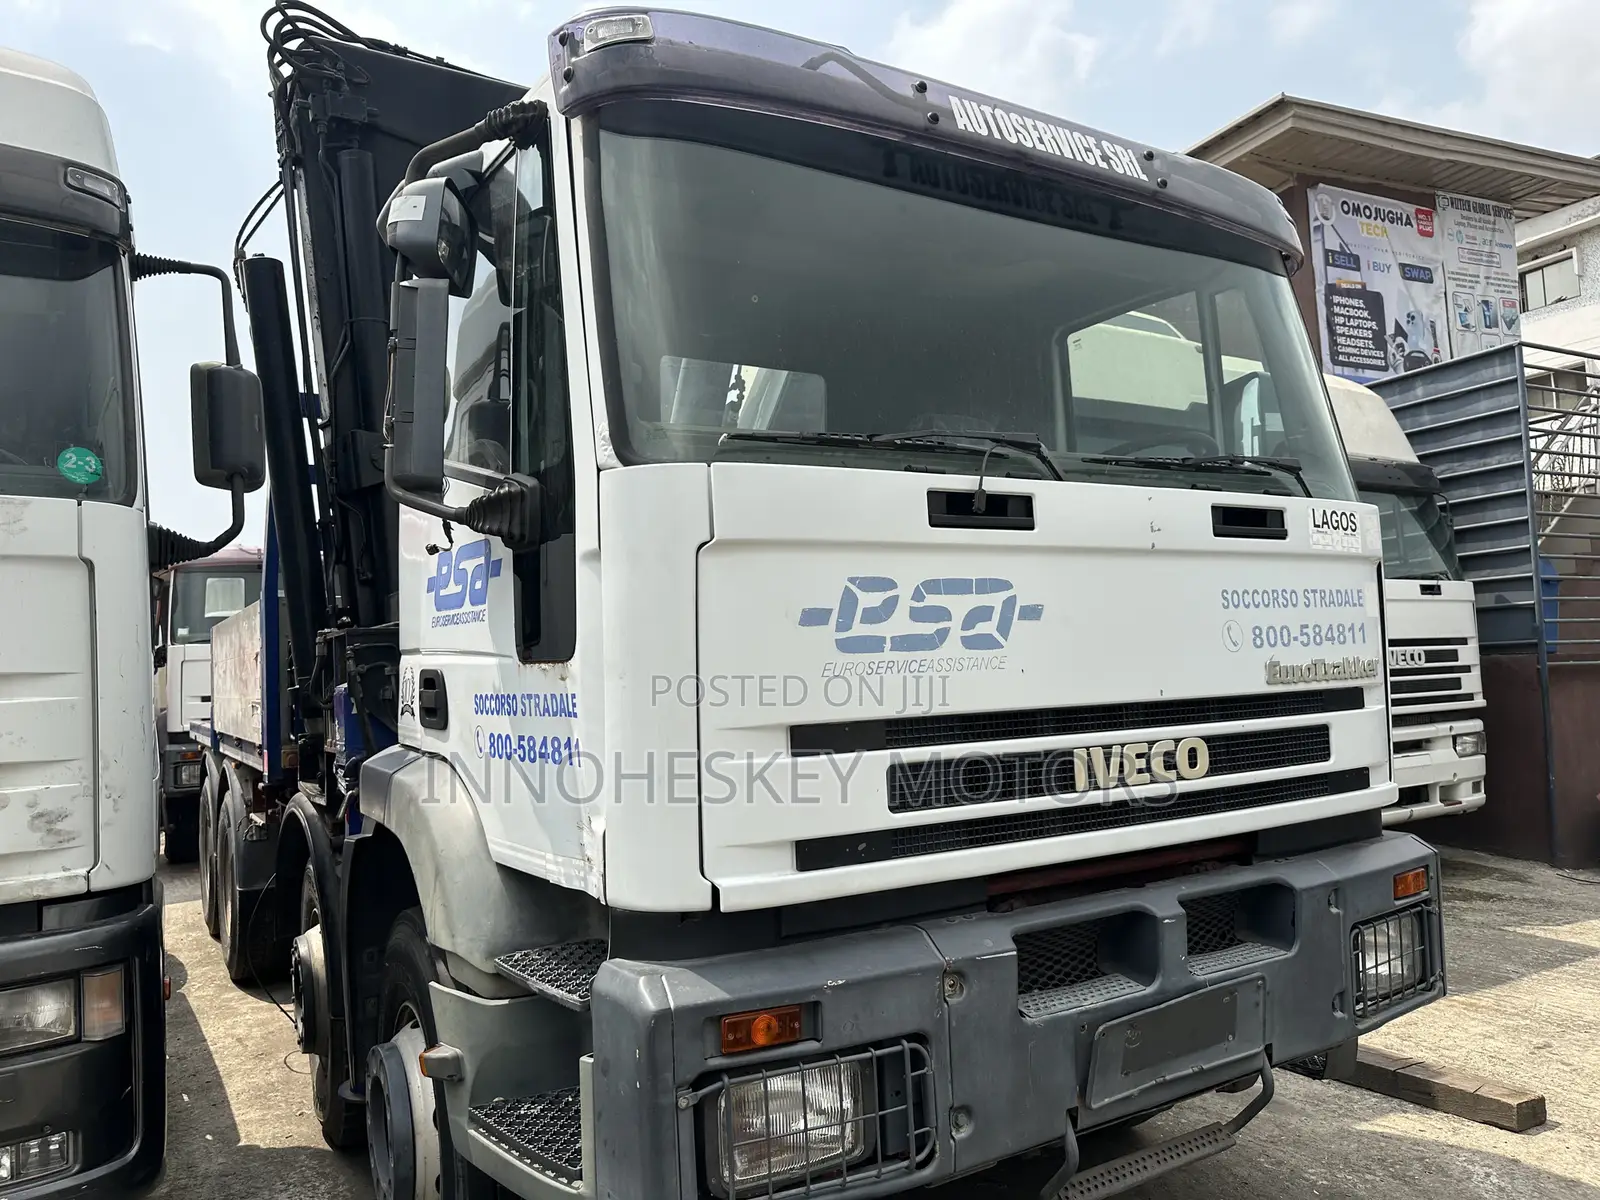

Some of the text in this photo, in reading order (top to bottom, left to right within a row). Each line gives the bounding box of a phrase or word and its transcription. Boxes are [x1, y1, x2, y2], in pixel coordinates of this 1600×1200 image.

[949, 95, 1149, 181] AUTOSERVICE SRL
[1340, 200, 1414, 228] OMOJUGHA
[1472, 201, 1492, 216] GLOBAL
[1360, 222, 1389, 238] TECH
[1334, 254, 1356, 268] SELL
[1372, 261, 1392, 274] BUY
[1404, 267, 1431, 280] SWAP
[1334, 316, 1344, 324] HP
[1336, 326, 1372, 338] SPEAKERS
[1338, 346, 1384, 358] GAMING DEVICES
[1350, 356, 1386, 366] ACCESSORIES
[64, 452, 96, 472] 2-3
[1312, 508, 1357, 532] LAGOS
[1220, 588, 1364, 610] SOCCORSO STRADALE
[431, 608, 486, 628] EUROSERVICEASSISTANCE
[1252, 622, 1367, 649] 800-584811
[821, 656, 1008, 678] EUROSERVICEASSISTANCE
[1388, 649, 1426, 666] VECO
[1265, 656, 1380, 685] EuroTrakker
[474, 693, 578, 718] SOCCORSO STRADALE
[488, 732, 582, 768] 800-584811
[1074, 737, 1210, 792] IVECO
